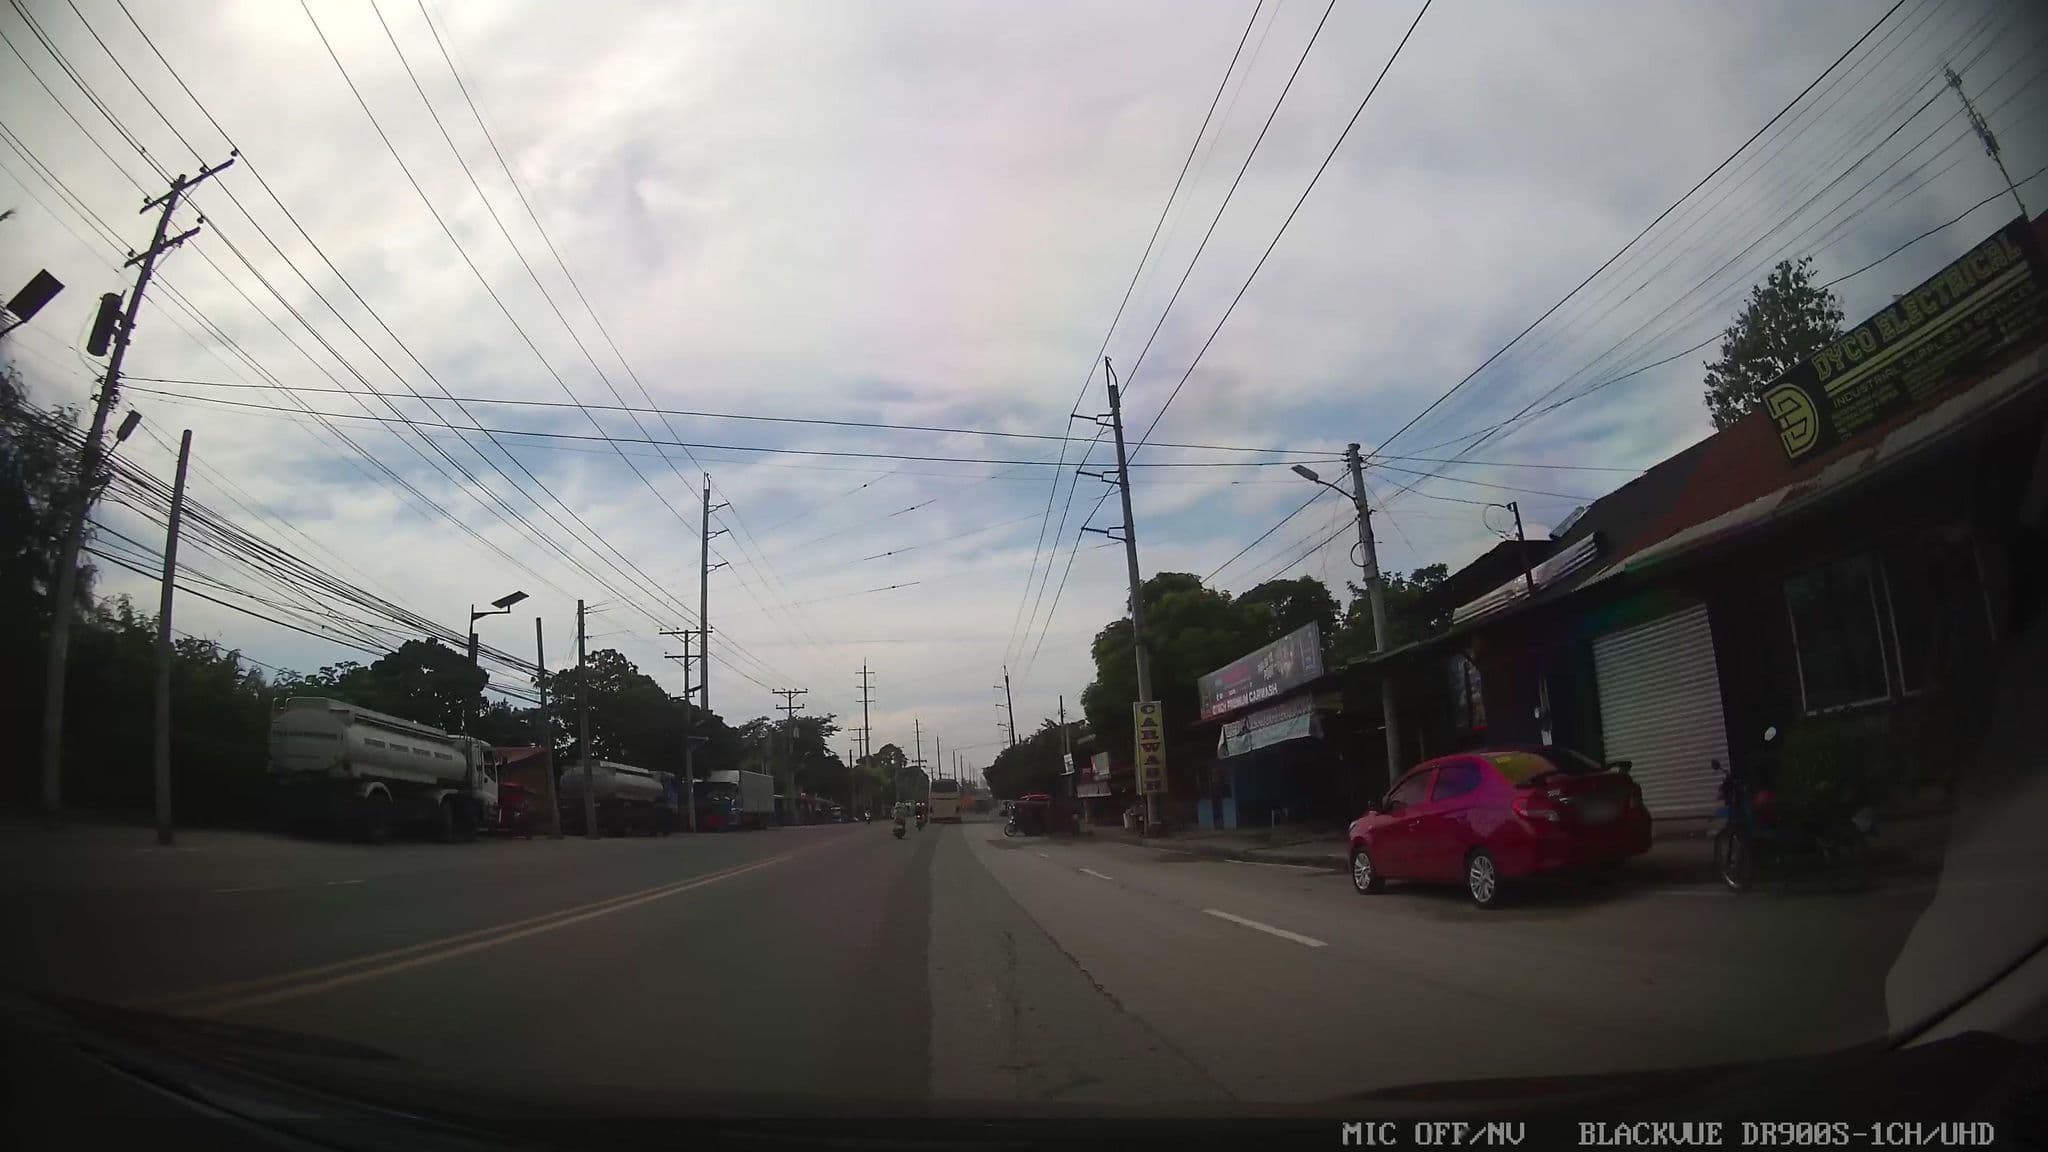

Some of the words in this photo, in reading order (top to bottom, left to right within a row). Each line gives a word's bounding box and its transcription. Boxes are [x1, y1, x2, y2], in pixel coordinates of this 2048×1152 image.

[1811, 328, 1877, 382] DYCO
[1874, 233, 2024, 342] ELECTRICAL
[1832, 367, 1902, 409] INDUSTRIAL
